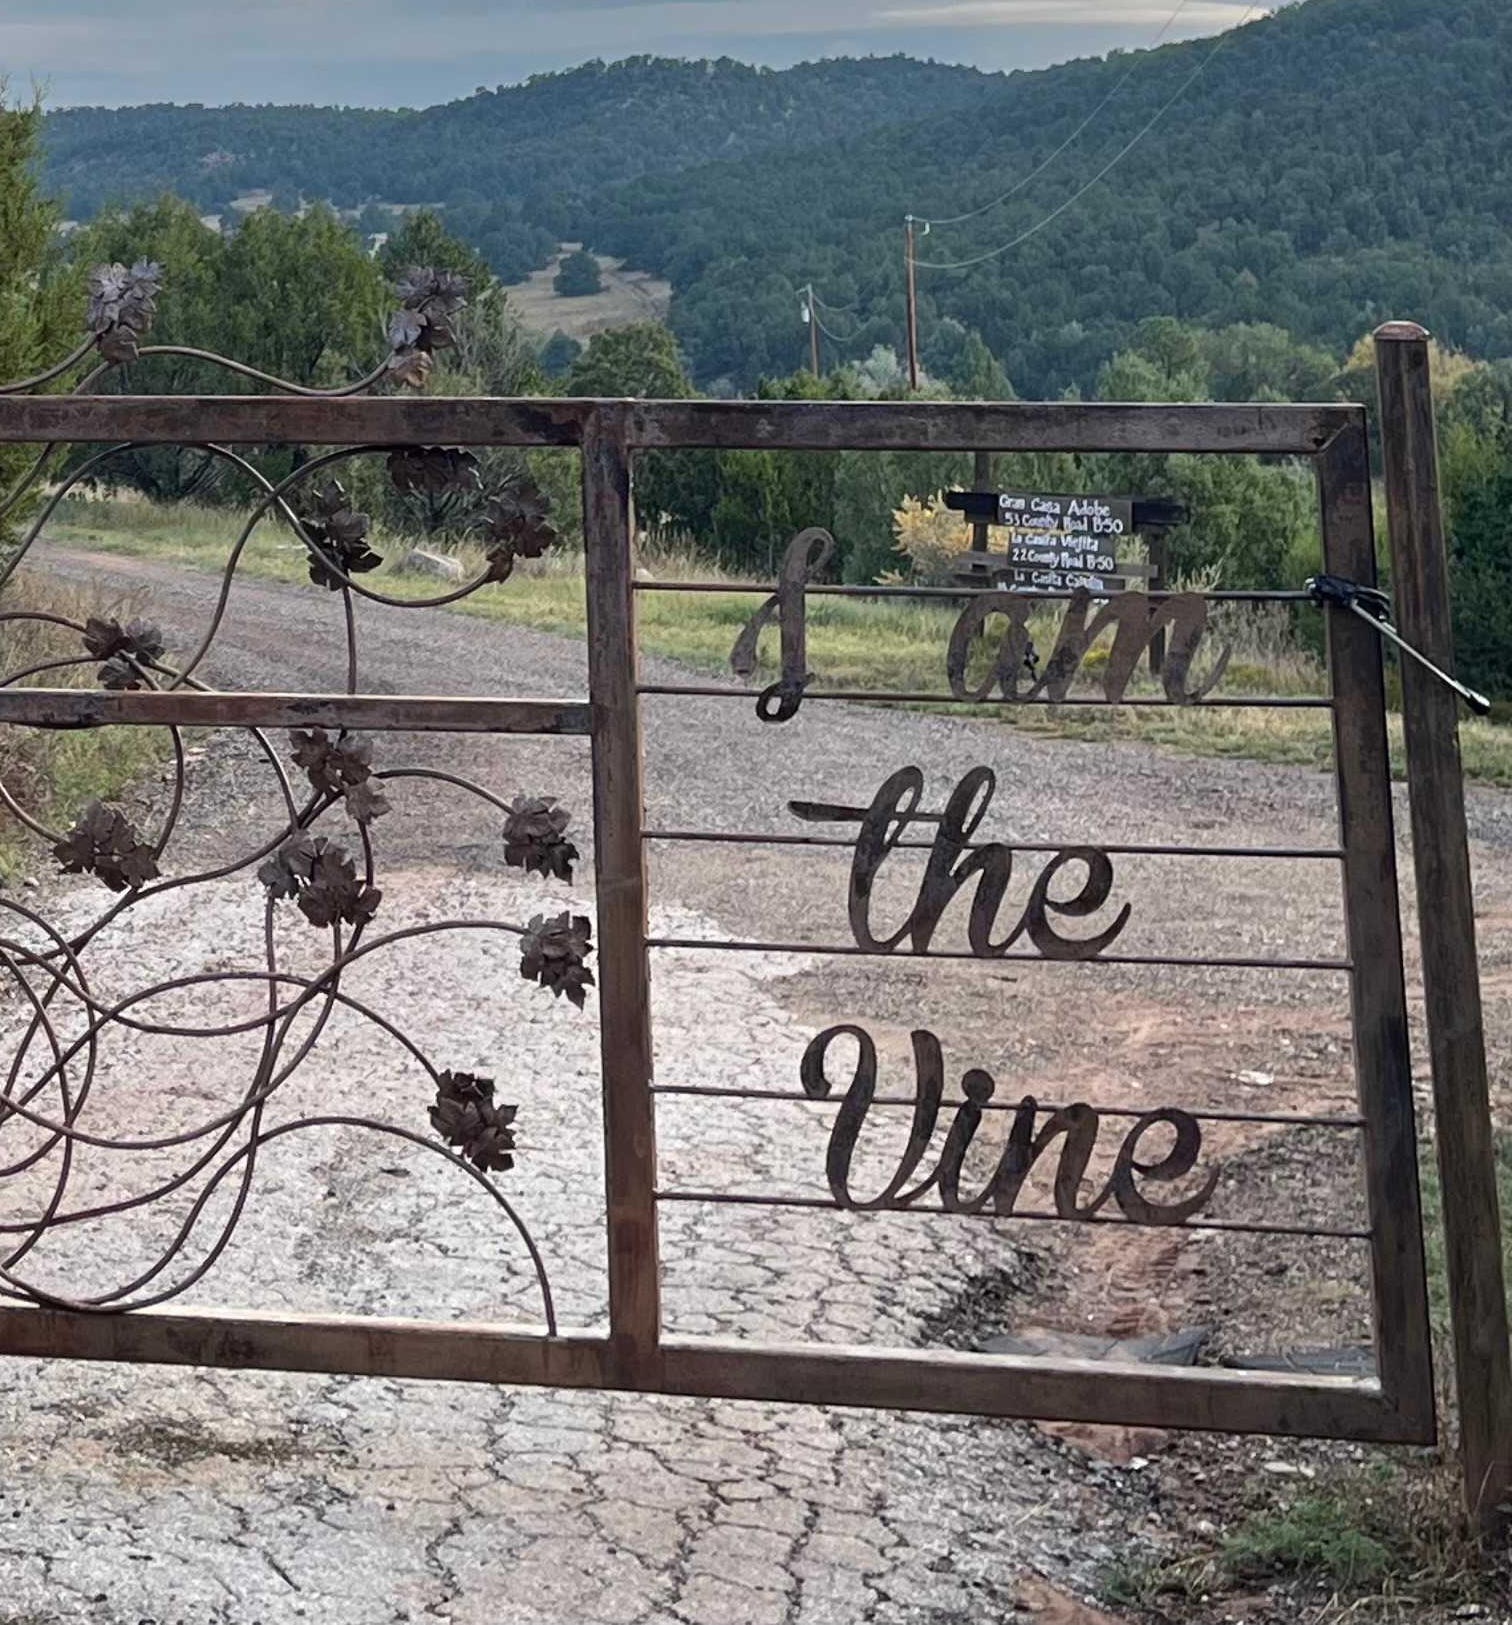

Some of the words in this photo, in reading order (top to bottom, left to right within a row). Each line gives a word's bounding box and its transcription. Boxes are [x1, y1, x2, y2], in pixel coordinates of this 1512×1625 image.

[1022, 513, 1059, 528] County
[1063, 516, 1088, 531] Road
[1068, 499, 1112, 517] Adobe
[1012, 547, 1027, 561] 22
[1028, 549, 1059, 568] County
[1061, 552, 1083, 568] Road
[947, 587, 1232, 706] am
[788, 765, 1133, 960] the
[799, 1024, 1222, 1227] Vine
